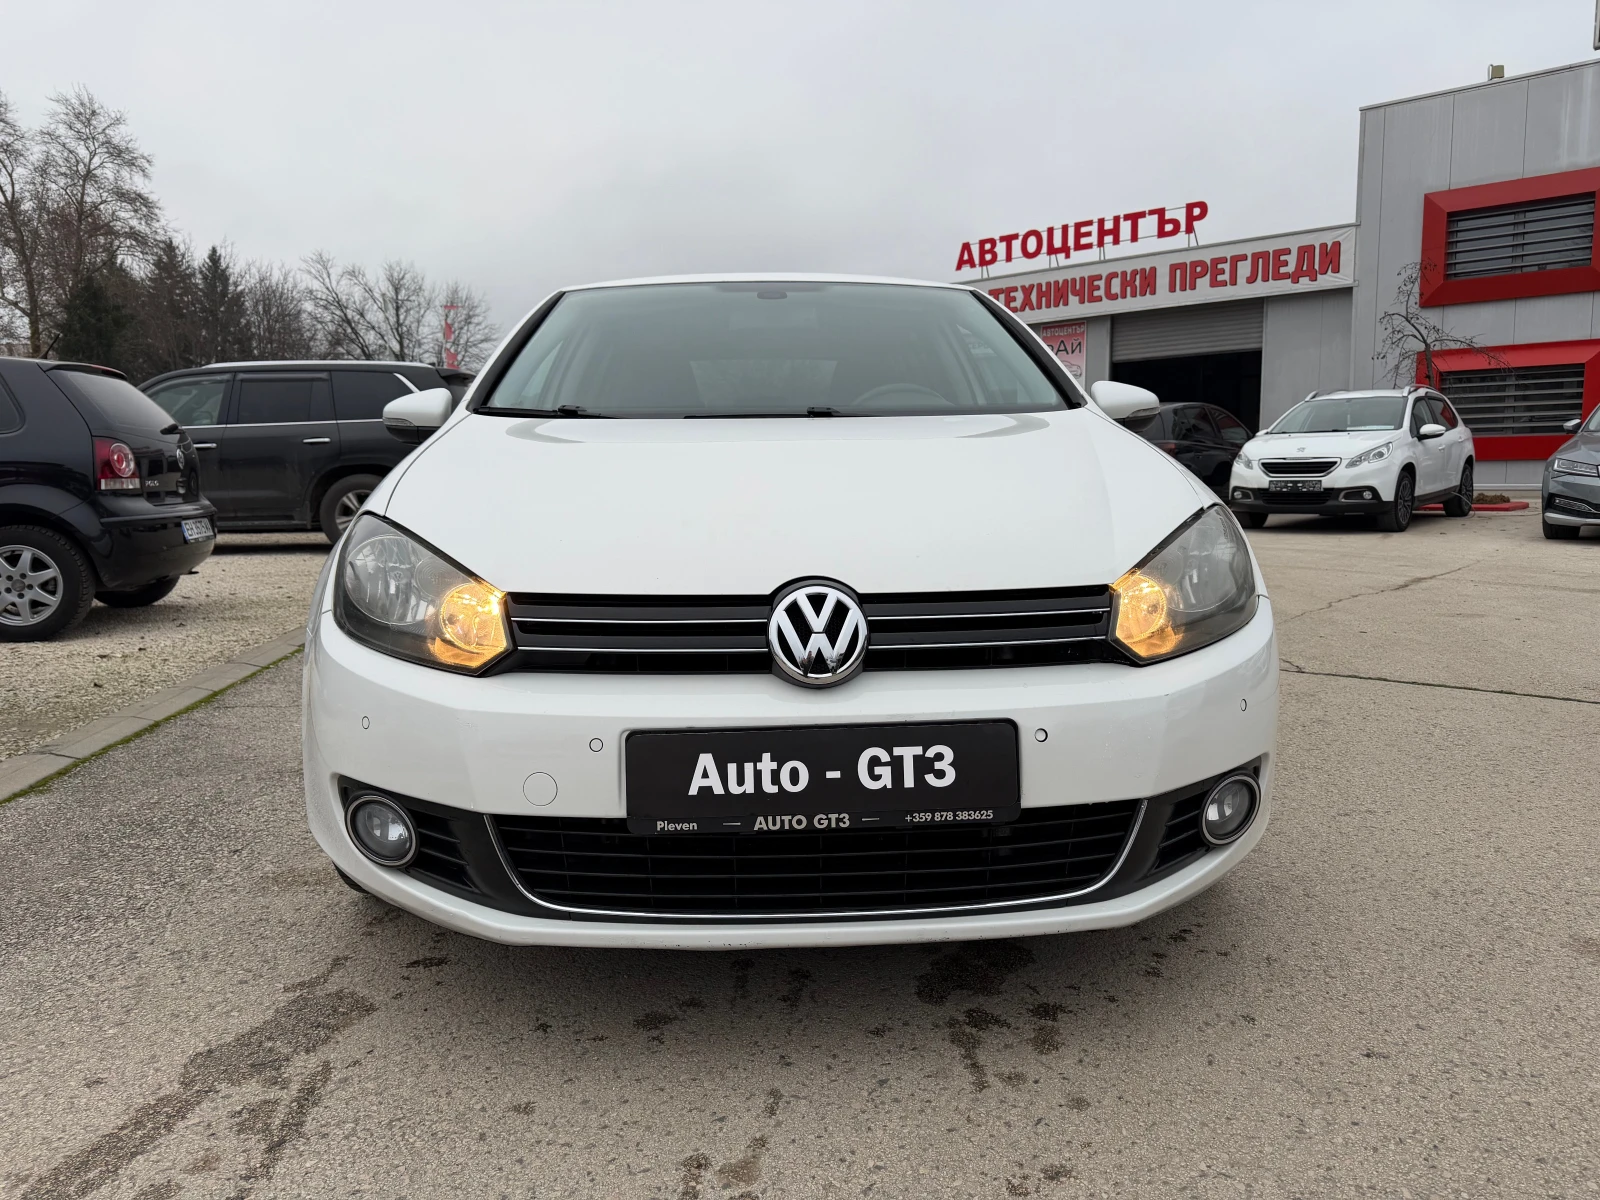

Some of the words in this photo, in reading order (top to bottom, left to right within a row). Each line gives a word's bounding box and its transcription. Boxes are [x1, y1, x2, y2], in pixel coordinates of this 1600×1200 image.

[955, 200, 1208, 271] АВТОЦЕНТЪР
[988, 267, 1156, 313] ТЕХНИЧЕСКИ
[1168, 240, 1341, 292] ПРЕГЛЕДИ
[1043, 324, 1085, 336] АВТОЦЕНТЪР
[771, 587, 866, 680] VW
[688, 752, 809, 795] Auto
[825, 770, 842, 779] -
[857, 744, 957, 790] GT3
[656, 820, 698, 832] Pleven
[753, 814, 808, 831] AUTO
[813, 813, 850, 829] GT3
[905, 813, 932, 822] +359
[934, 811, 954, 821] 878
[955, 810, 994, 820] 383625
